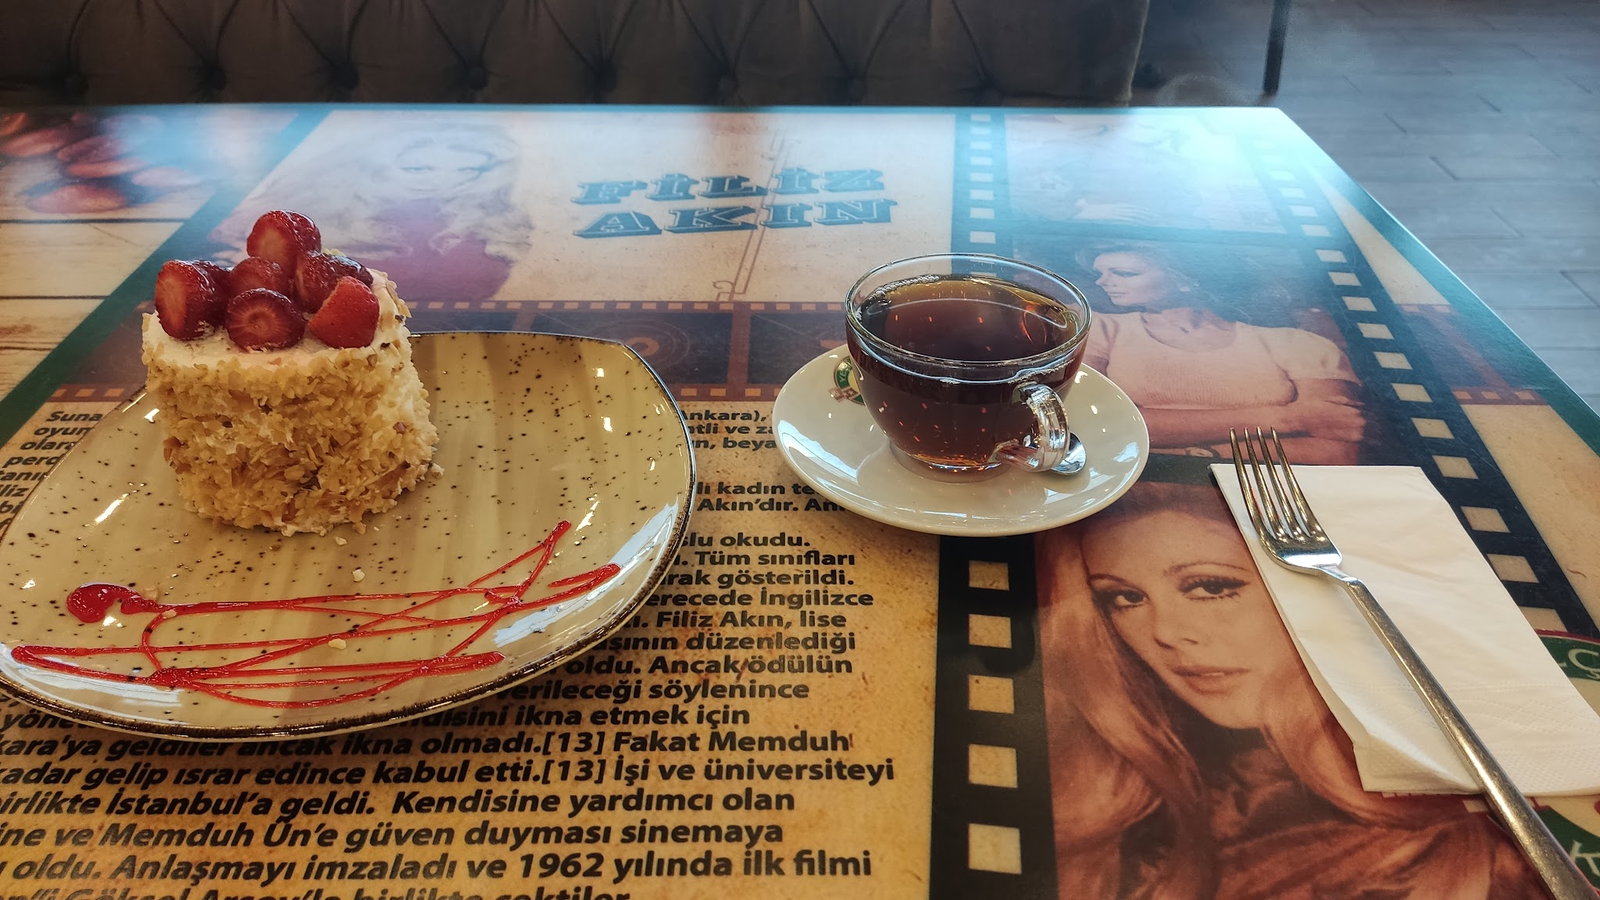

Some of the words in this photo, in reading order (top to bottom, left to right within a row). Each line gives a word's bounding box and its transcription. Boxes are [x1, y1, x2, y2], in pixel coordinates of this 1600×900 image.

[573, 198, 898, 238] AKIN
[46, 411, 103, 422] Suna
[725, 426, 750, 434] ve
[718, 481, 786, 494] kadın
[697, 498, 799, 511] Akın’dır.
[720, 532, 811, 547] okudu.
[694, 551, 750, 566] Tüm
[758, 549, 855, 566] sınıfları
[717, 569, 855, 589] gösterildi.
[760, 586, 874, 610] İngilizce
[656, 611, 713, 628] Filiz
[719, 611, 792, 630] Akın,
[799, 611, 847, 627] lise
[685, 632, 856, 654] düzenlediği
[566, 655, 642, 674] oldu.
[649, 654, 740, 674] Ancak
[747, 653, 853, 673] ödülün
[648, 680, 810, 703] söylenince
[515, 706, 582, 726] ikna
[590, 705, 689, 726] etmek
[697, 704, 750, 728] için
[238, 737, 333, 756] ancak
[341, 733, 412, 756] ikna
[613, 731, 699, 752] Fakat
[708, 730, 850, 752] Memduh
[80, 761, 168, 790] gelip
[173, 766, 250, 785] ısrar
[254, 762, 366, 785] edince
[372, 760, 469, 784] kabul
[613, 755, 650, 786] İşi
[658, 765, 695, 781] ve
[704, 758, 894, 786] üniversiteyi
[105, 787, 271, 816] İstanbul’a
[279, 791, 375, 820] geldi.
[391, 789, 561, 814] Kendisine
[567, 787, 713, 818] yardımcı
[722, 786, 795, 811] olan
[54, 828, 94, 846] ve
[99, 821, 255, 846] Memduh
[344, 821, 455, 853] güven
[463, 819, 611, 851] duyması
[620, 818, 783, 848] sinemaya
[12, 854, 101, 880] oldu.
[107, 854, 296, 888] Anlaşmayı
[302, 853, 456, 880] imzaladı
[467, 859, 507, 879] ve
[520, 852, 605, 878] 1962
[612, 851, 732, 885] yılında
[743, 849, 786, 877] ilk
[794, 849, 872, 876] filmi
